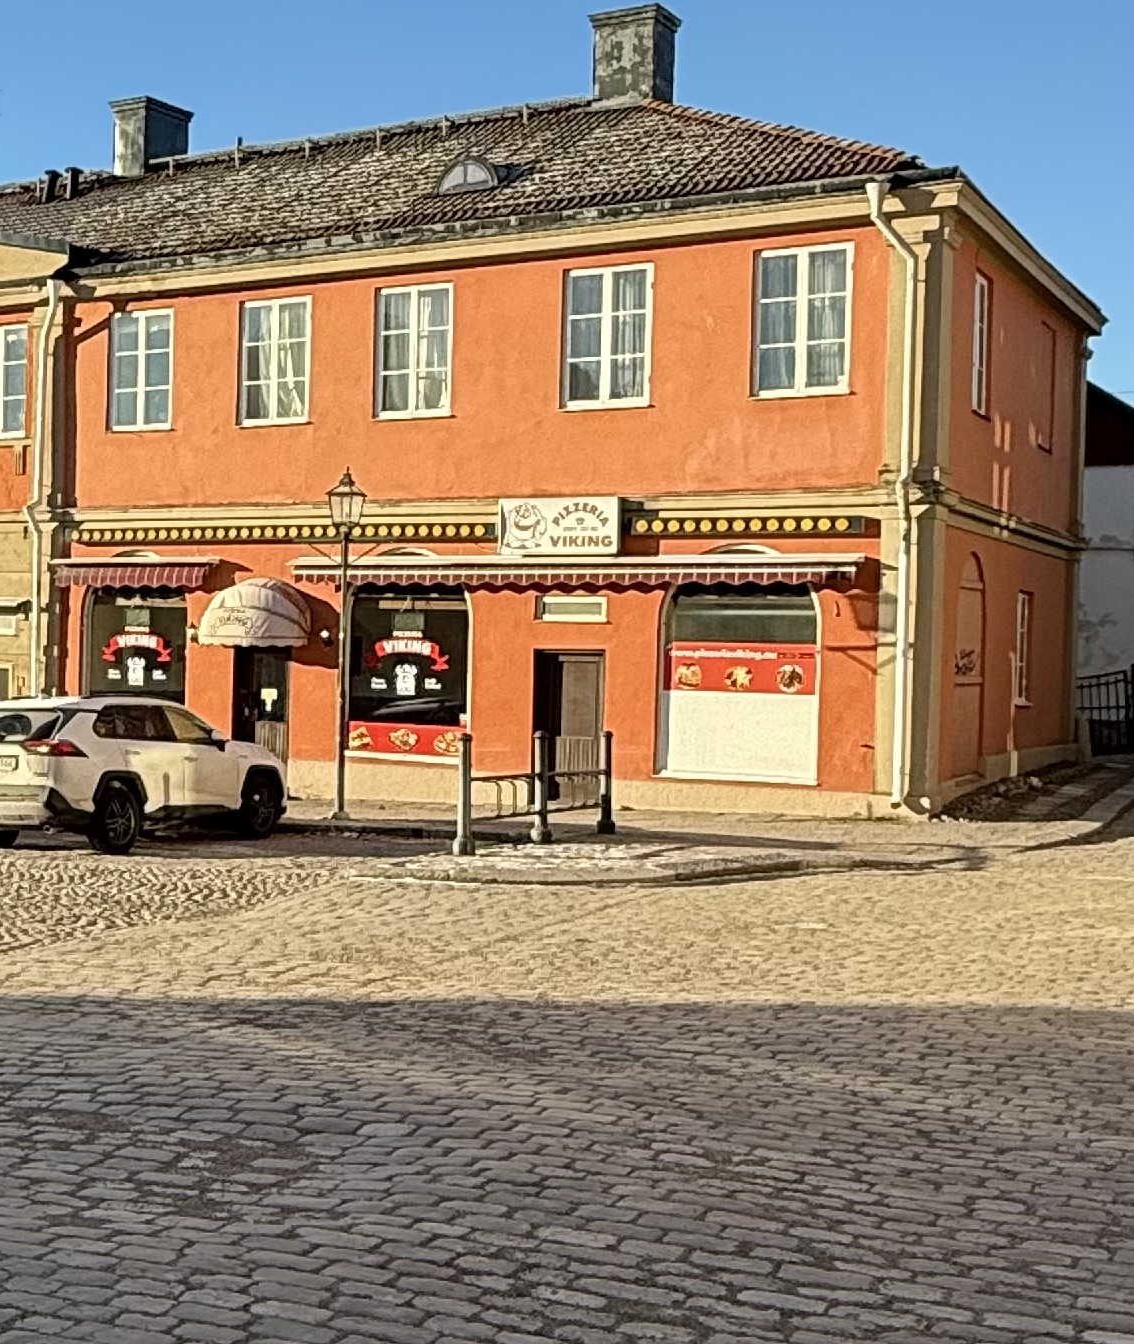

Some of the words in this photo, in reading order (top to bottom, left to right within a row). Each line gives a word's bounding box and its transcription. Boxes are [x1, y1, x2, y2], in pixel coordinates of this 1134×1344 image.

[551, 502, 610, 527] PIZZERIA
[549, 535, 614, 548] VIKING
[116, 634, 158, 649] VIKING
[382, 639, 433, 656] VIKING
